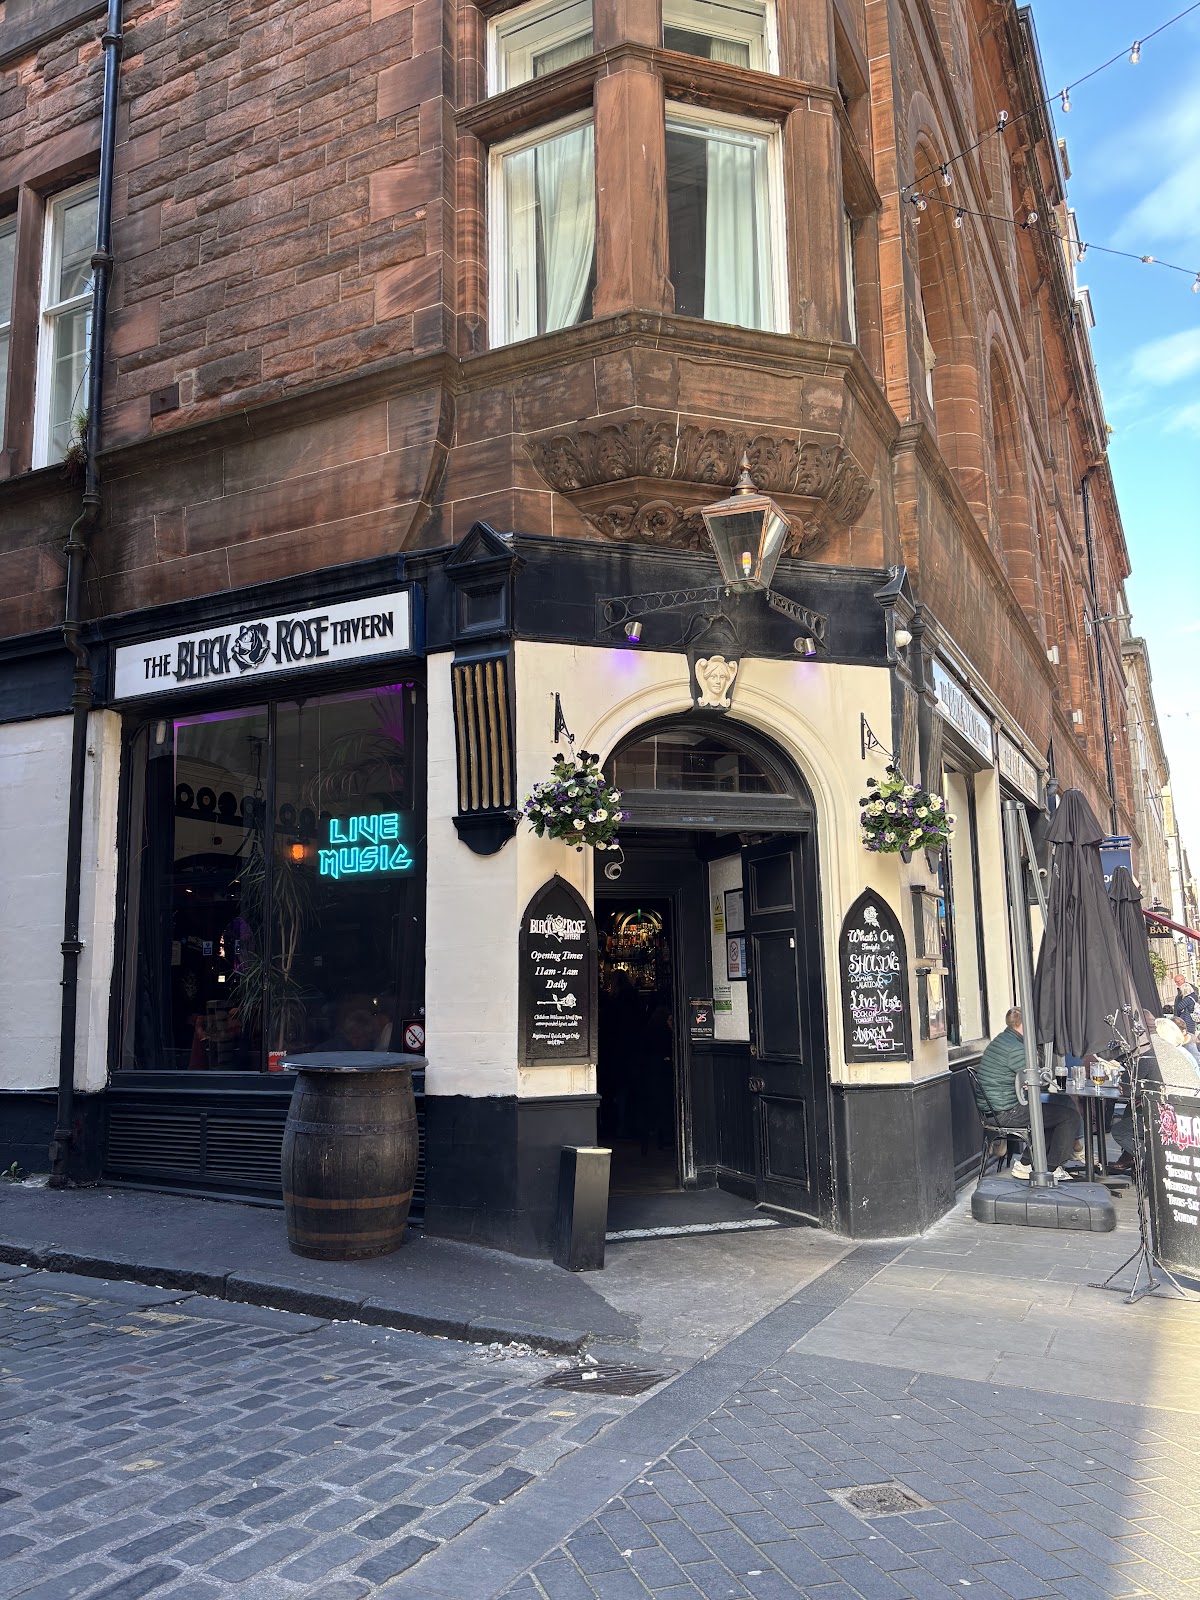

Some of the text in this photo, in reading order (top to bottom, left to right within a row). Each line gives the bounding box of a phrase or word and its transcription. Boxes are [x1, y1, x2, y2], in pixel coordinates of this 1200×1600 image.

[144, 611, 393, 682] THE BLACK ROSE TAVERN
[330, 813, 398, 844] LIVE
[318, 843, 412, 879] MUSIC
[529, 919, 586, 933] BLACK ROSE
[1149, 925, 1170, 934] BAR
[847, 929, 894, 942] What's On
[531, 950, 584, 962] Opening Times
[848, 951, 900, 974] SHOWING
[535, 966, 556, 975] 11am
[562, 966, 579, 975] 1am
[545, 979, 568, 991] Daily
